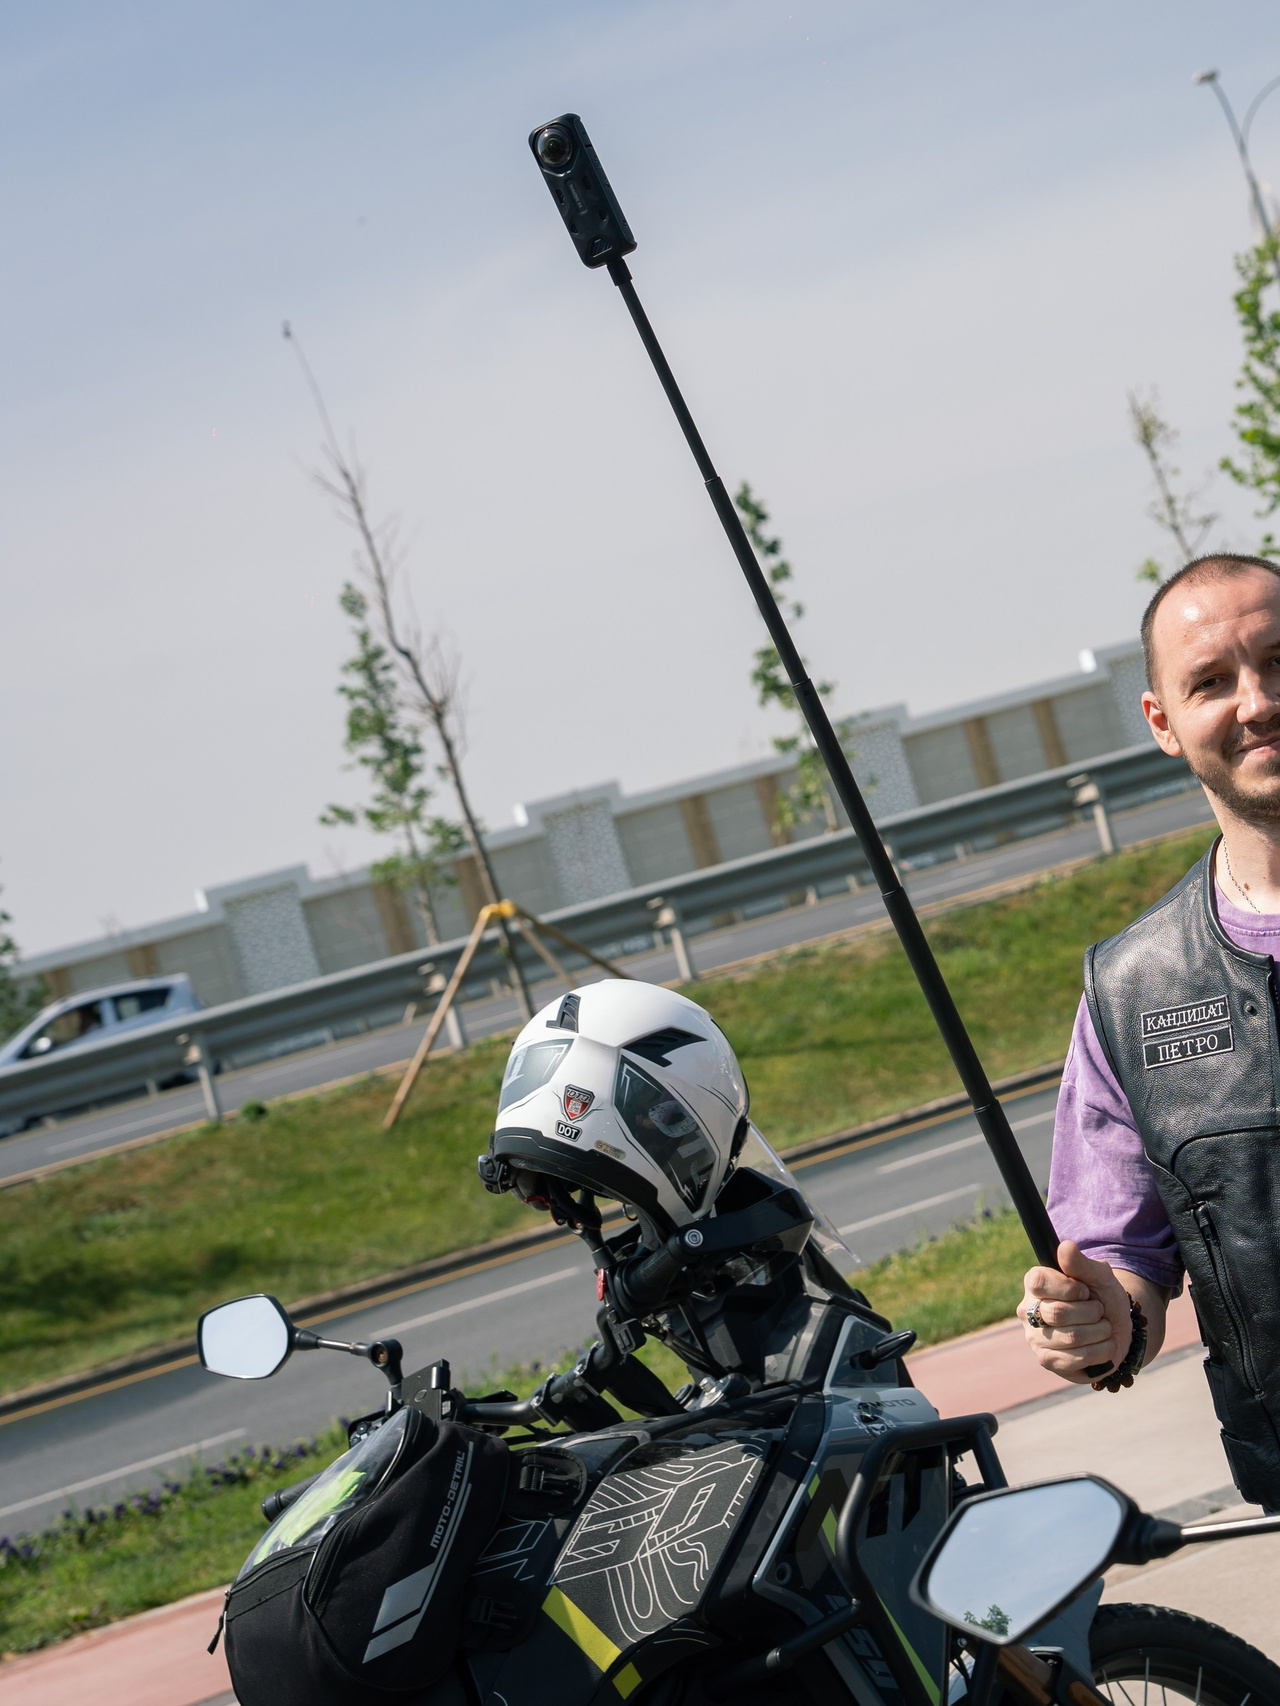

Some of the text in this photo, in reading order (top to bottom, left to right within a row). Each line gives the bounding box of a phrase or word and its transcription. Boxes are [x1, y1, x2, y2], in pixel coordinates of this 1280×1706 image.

[1146, 1002, 1225, 1031] КАНДИДАТ
[1157, 1034, 1218, 1062] ПЕТРО
[558, 1123, 578, 1139] DOT
